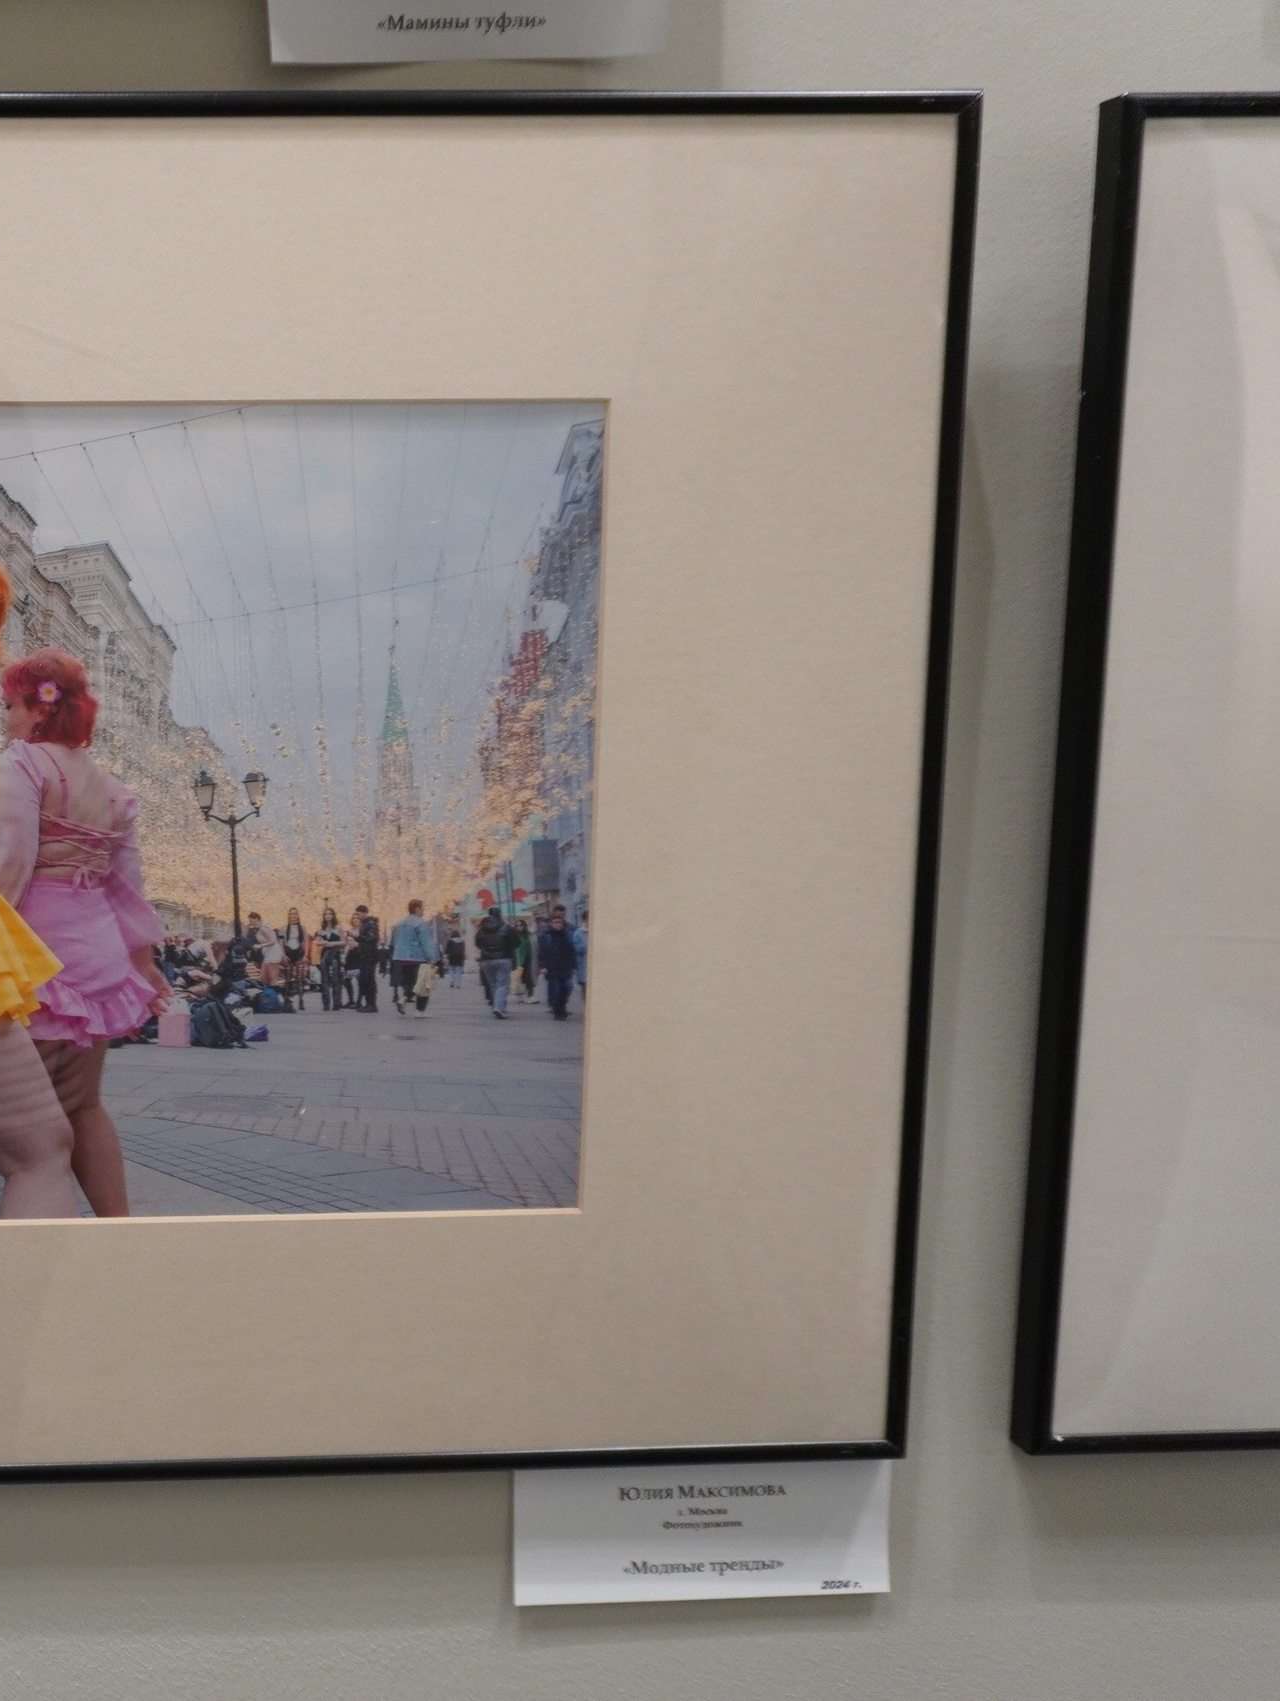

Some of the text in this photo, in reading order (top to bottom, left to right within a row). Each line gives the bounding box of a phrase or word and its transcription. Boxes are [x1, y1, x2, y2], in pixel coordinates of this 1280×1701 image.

[377, 11, 547, 35] «Мамины туфли»
[623, 1559, 785, 1576] «Модные тренды»
[821, 1580, 863, 1590] 2024 г.
